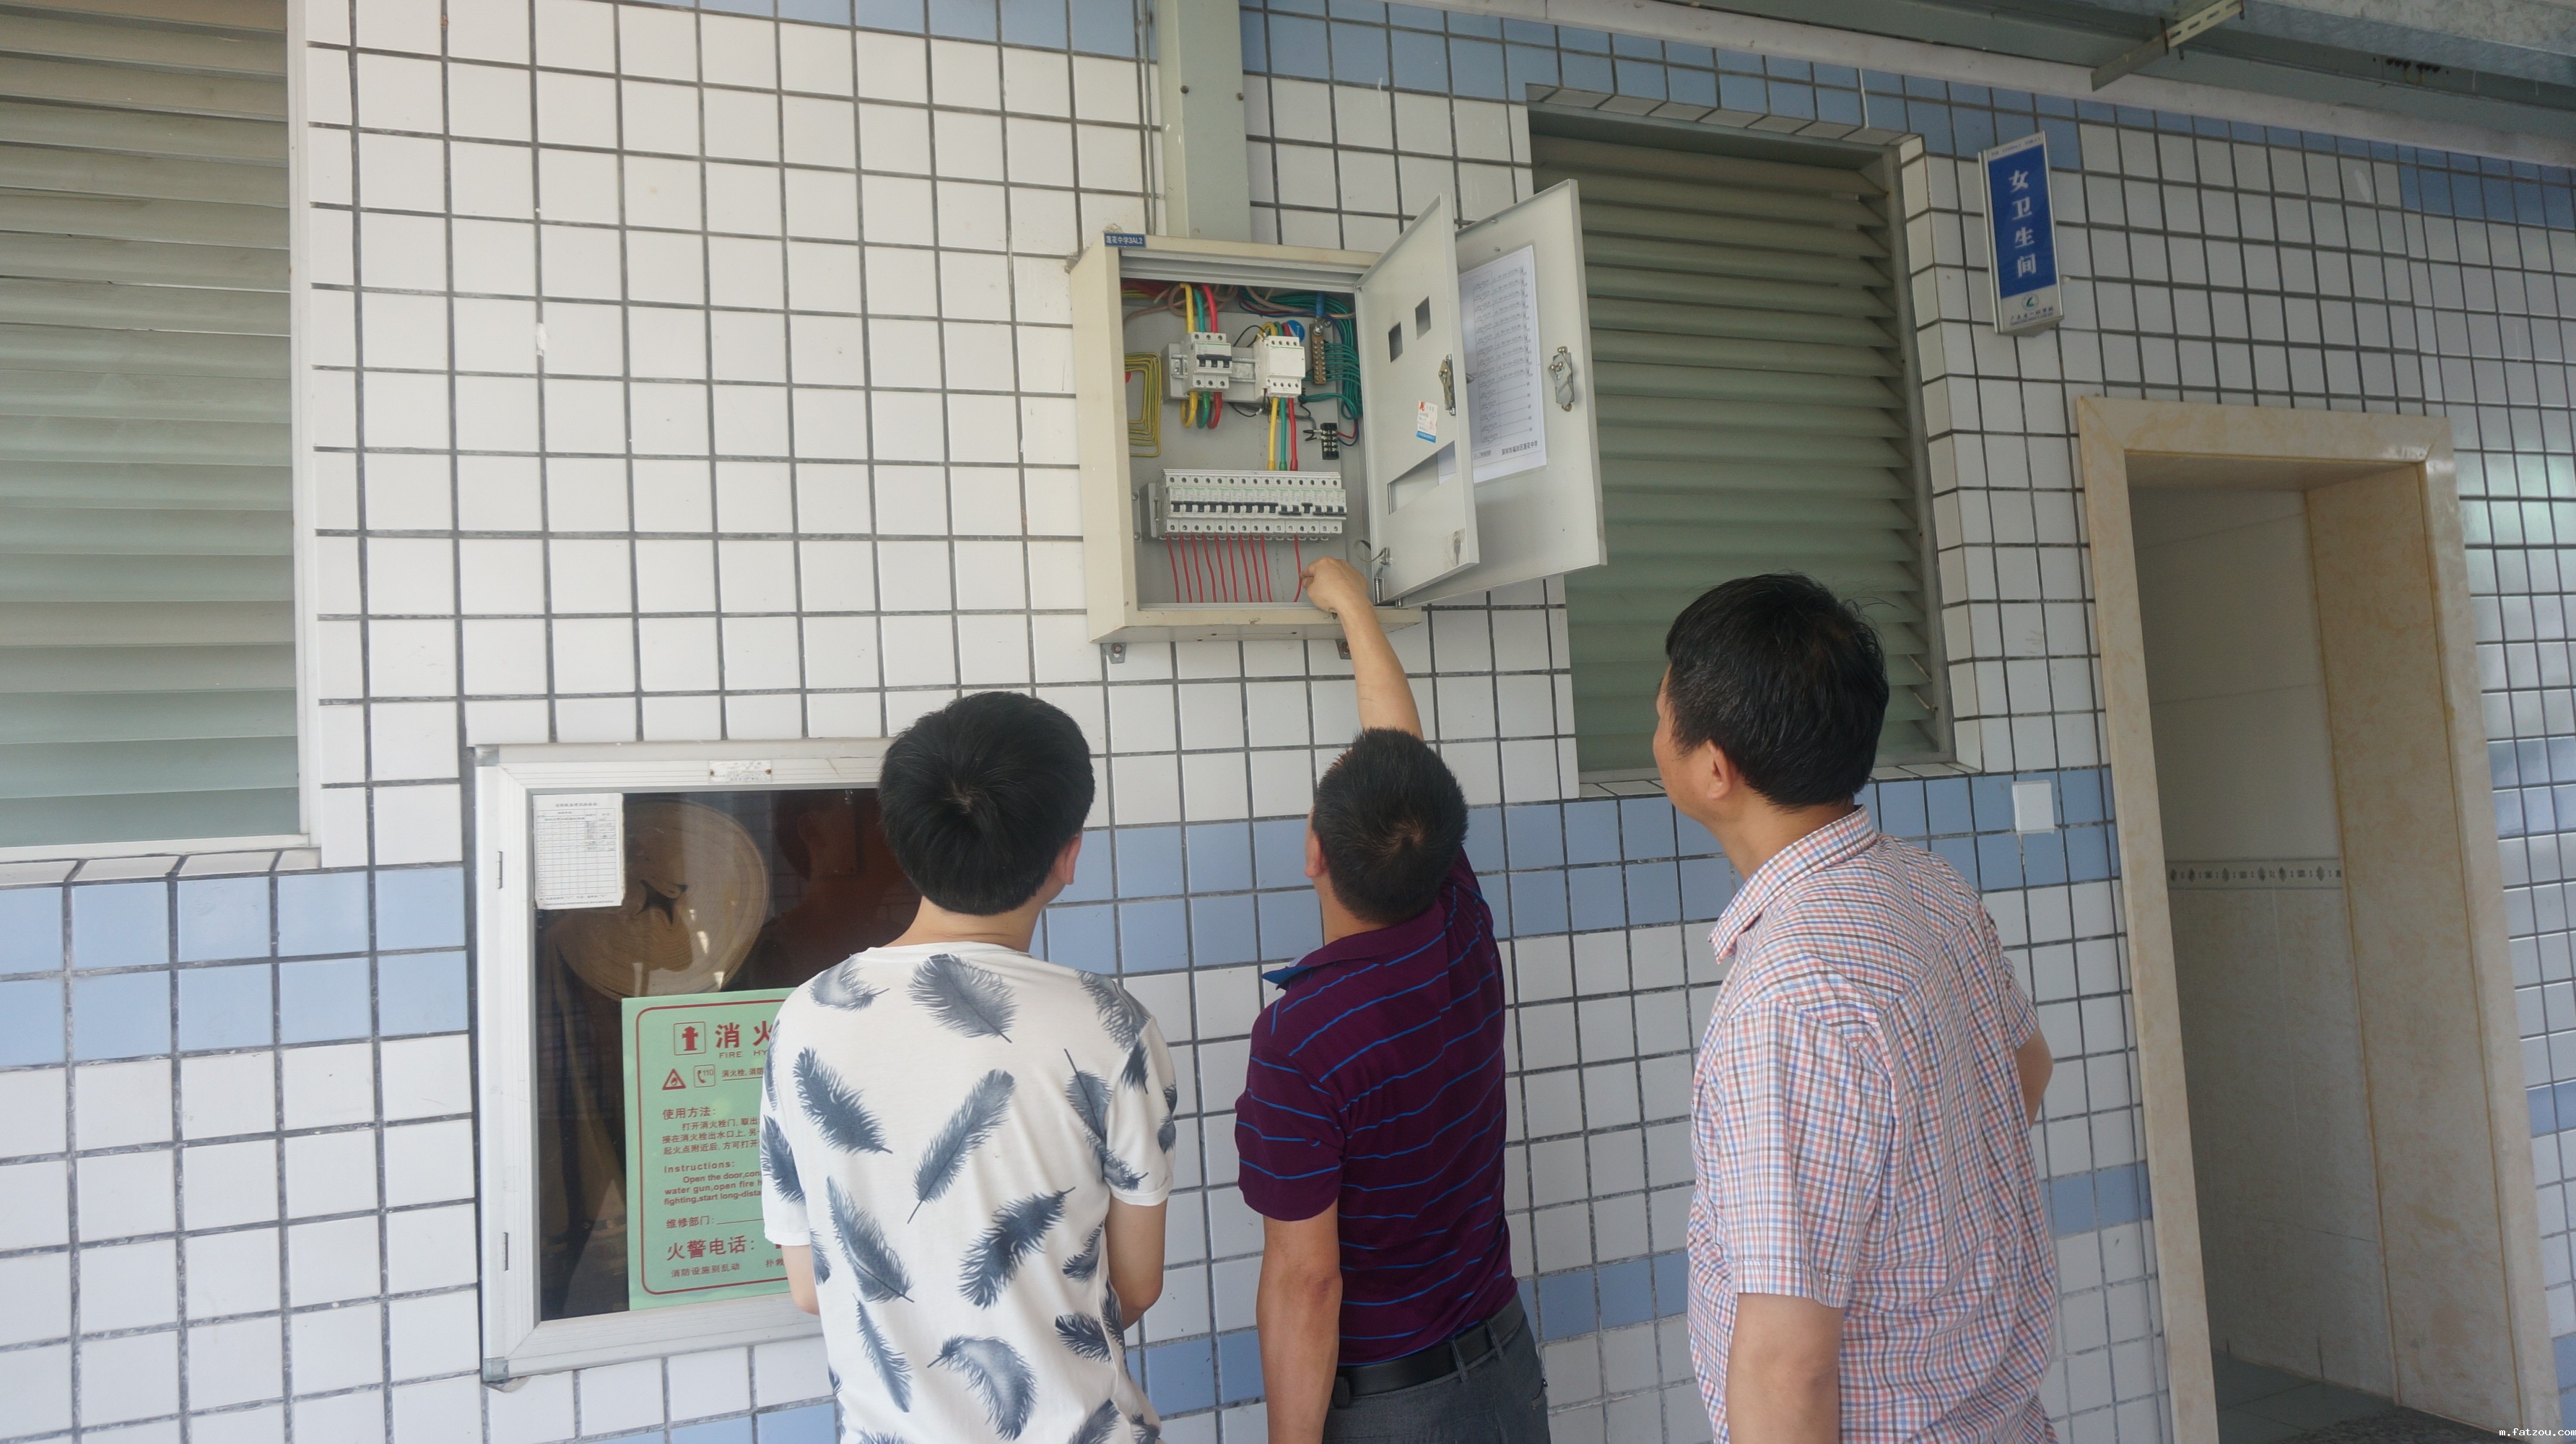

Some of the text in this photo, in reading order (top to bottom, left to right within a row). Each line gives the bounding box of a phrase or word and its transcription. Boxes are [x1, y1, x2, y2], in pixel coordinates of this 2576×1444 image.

[2009, 169, 2037, 279] 女卫生间
[1105, 235, 1143, 245] 莲花中学3AL2
[719, 1051, 743, 1059] FIRE
[662, 1105, 716, 1121] 使用方法:
[664, 1160, 735, 1173] Instructions:
[682, 1175, 705, 1184] Open
[723, 1170, 761, 1180] door,con
[664, 1186, 690, 1196] water
[693, 1181, 736, 1193] gun,open
[739, 1180, 754, 1188] fire
[663, 1193, 718, 1206] fighting,start
[666, 1215, 715, 1230] 维修部门:
[666, 1235, 754, 1261] 火警电话:
[671, 1263, 740, 1278] 消防设施别乱动
